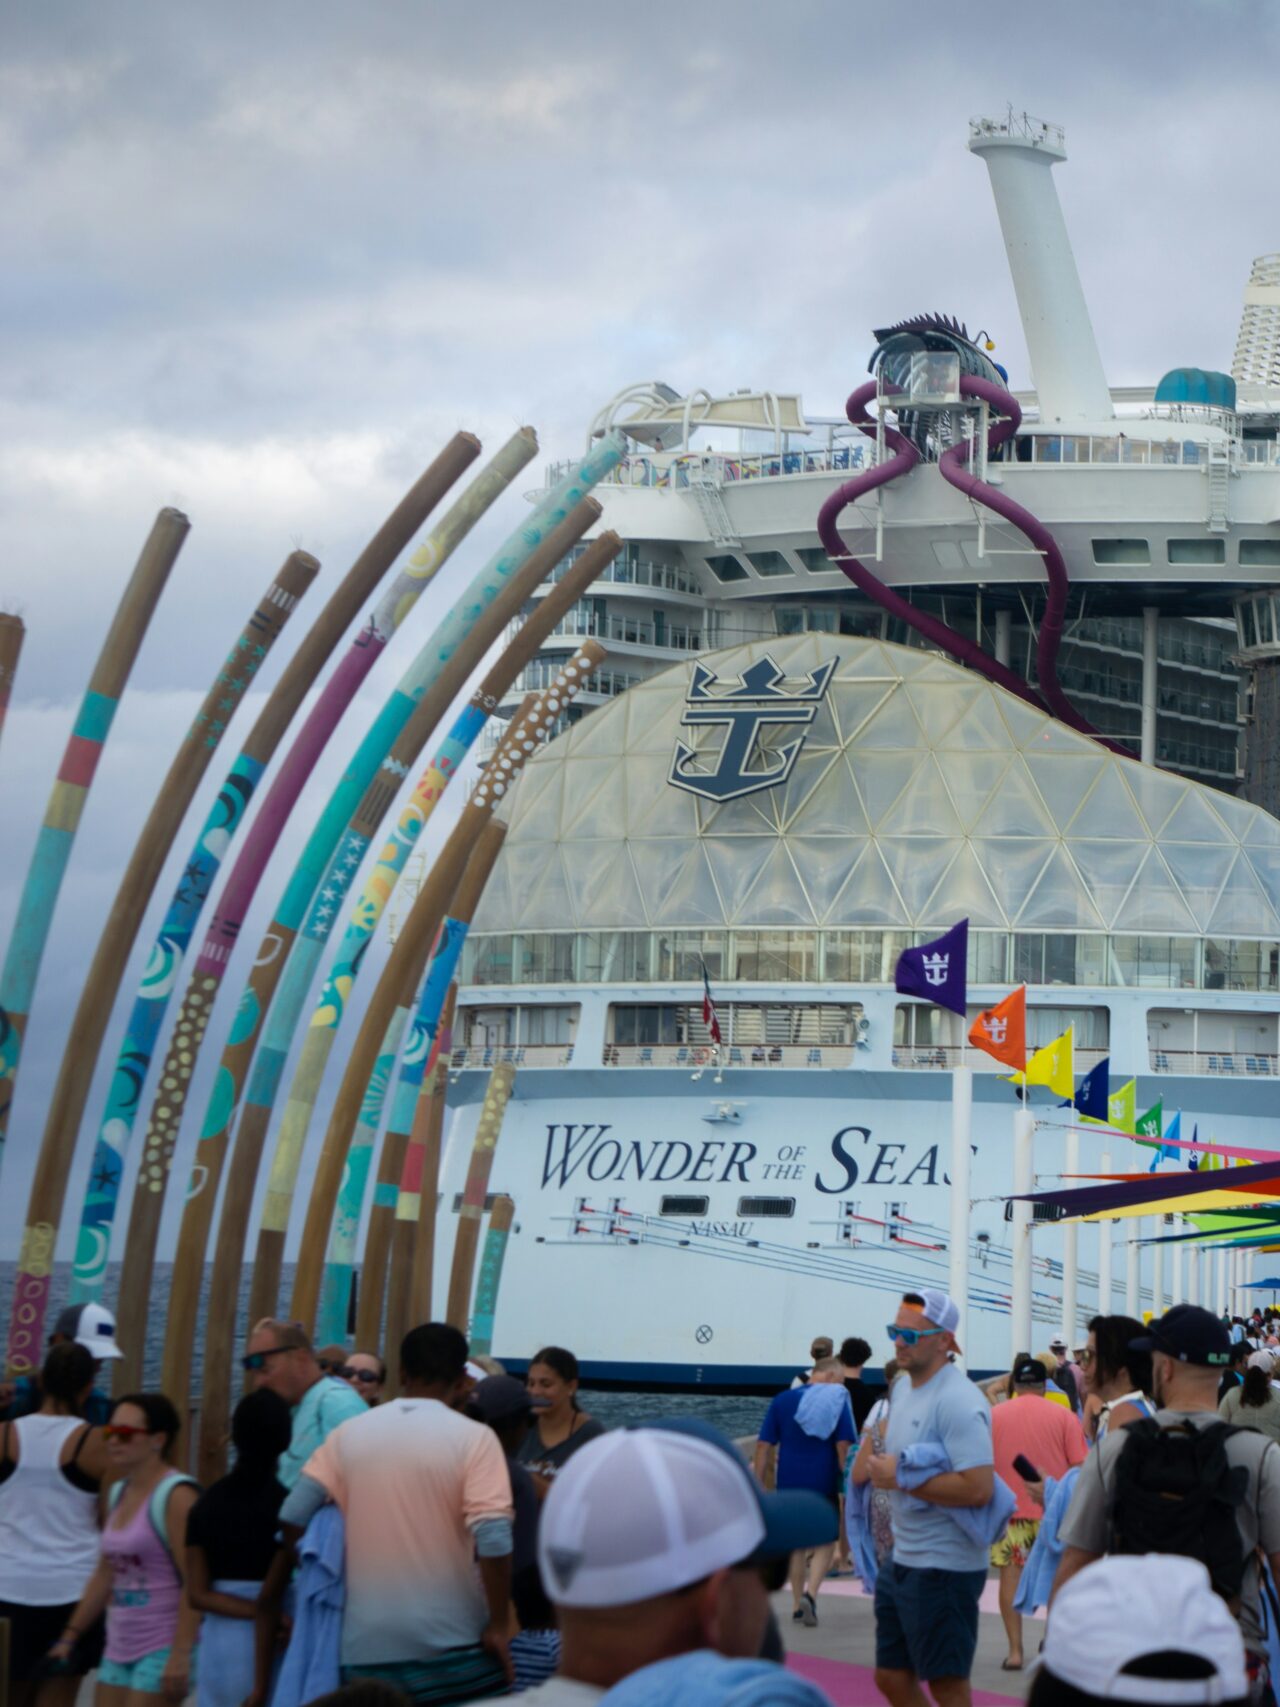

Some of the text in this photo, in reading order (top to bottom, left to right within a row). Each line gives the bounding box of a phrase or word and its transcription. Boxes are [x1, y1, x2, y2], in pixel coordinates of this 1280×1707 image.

[541, 1124, 757, 1190] WONDER
[777, 1145, 807, 1161] OF
[762, 1164, 806, 1180] THE
[686, 1221, 754, 1238] NASSAU
